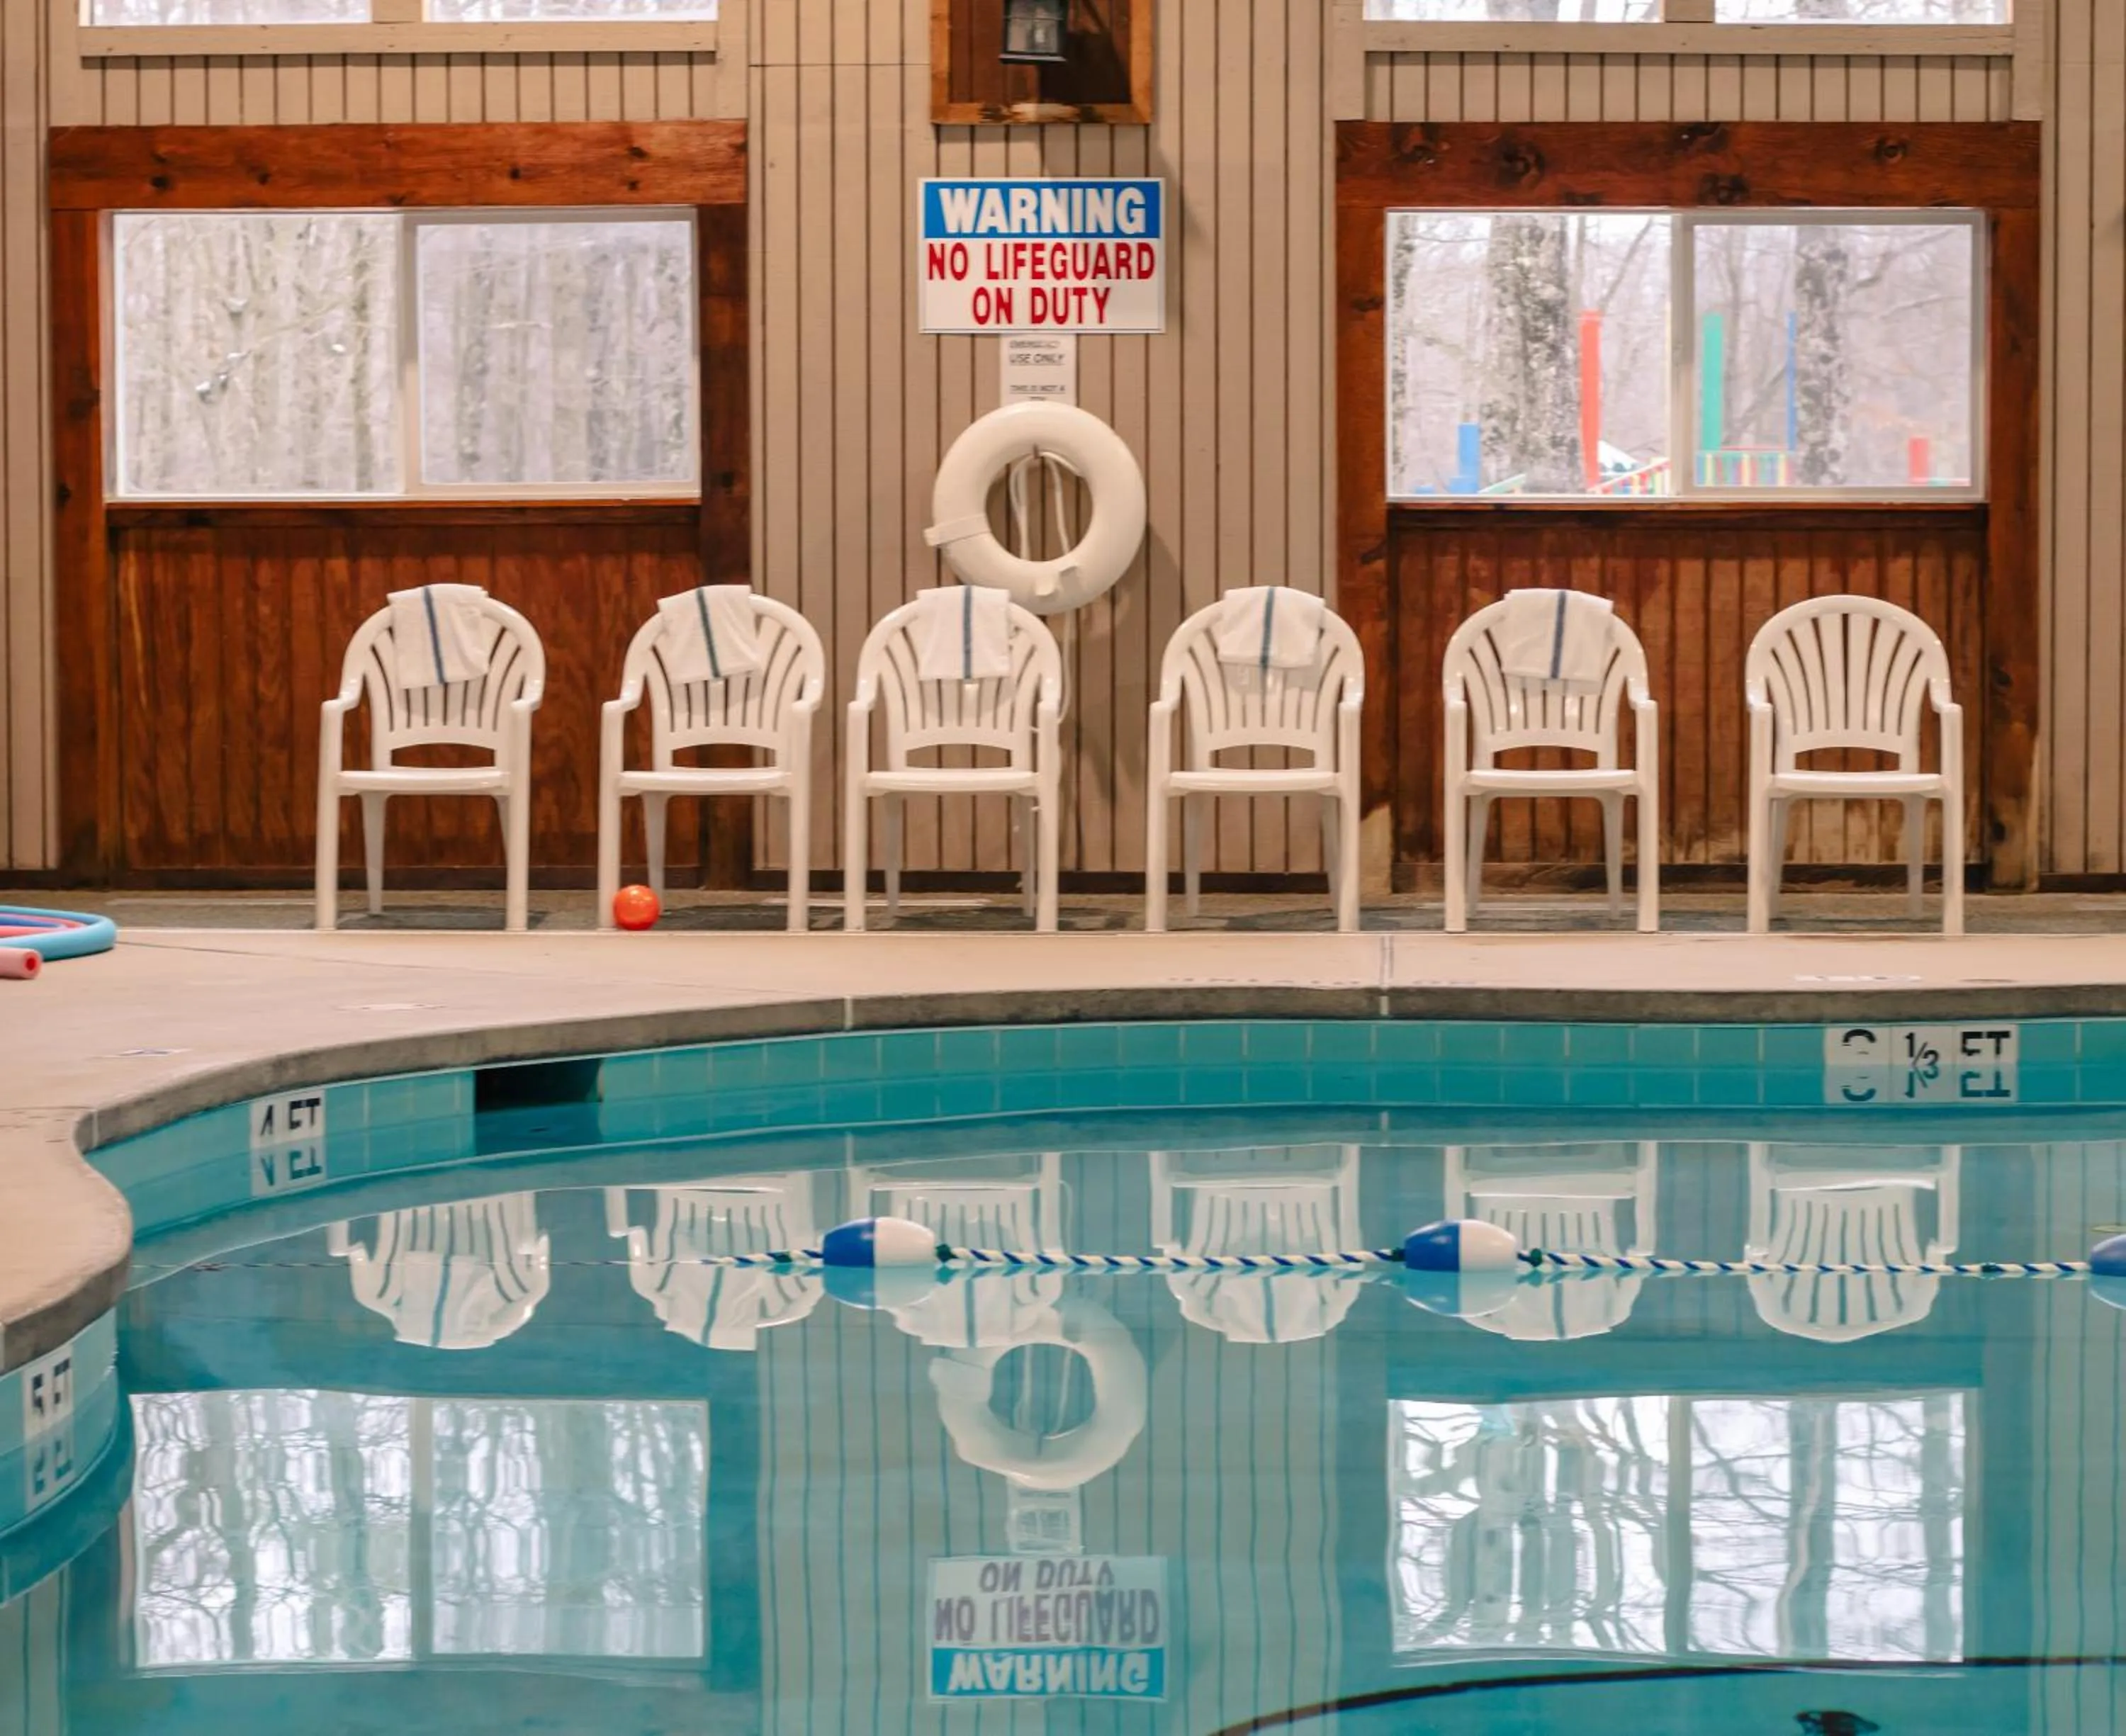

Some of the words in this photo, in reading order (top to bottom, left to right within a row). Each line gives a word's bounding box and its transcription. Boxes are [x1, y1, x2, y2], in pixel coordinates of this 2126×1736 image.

[938, 186, 1146, 235] WARNING
[928, 242, 969, 281] NO
[986, 242, 1155, 281] LIFEGUARD
[972, 286, 1013, 325] ON
[1030, 286, 1110, 325] DUTY
